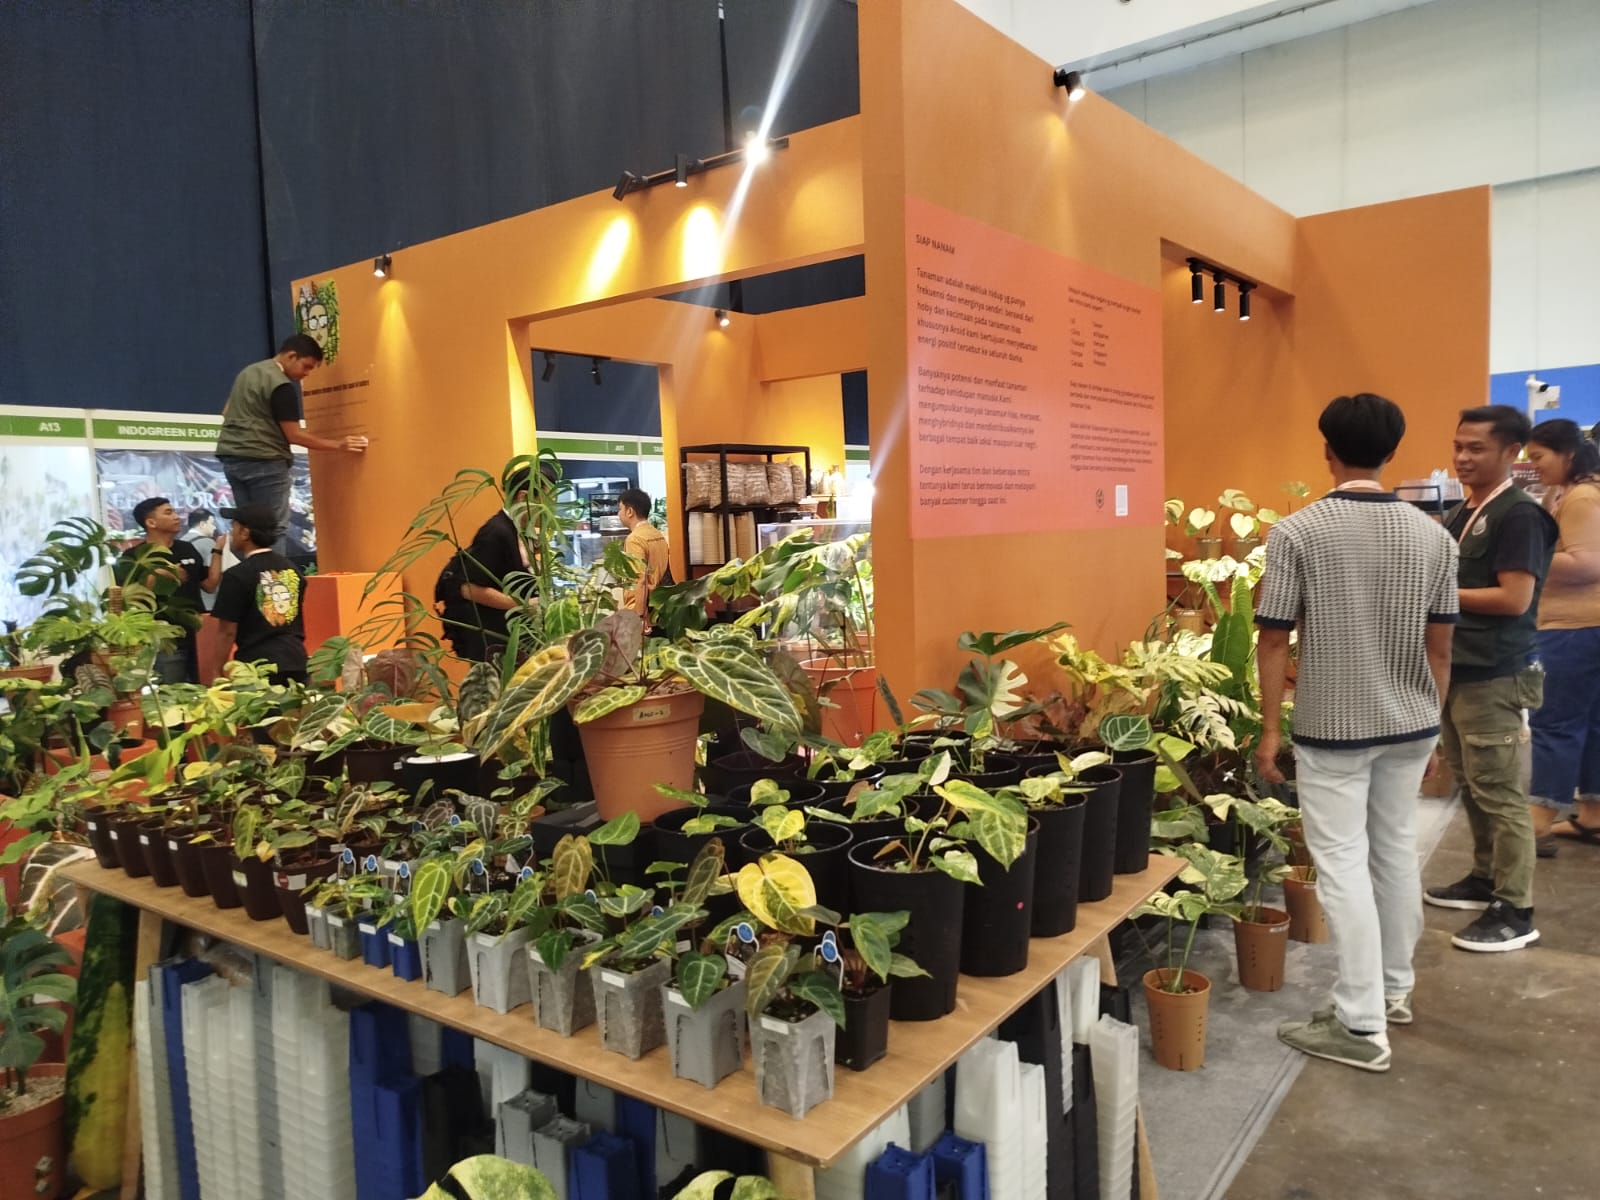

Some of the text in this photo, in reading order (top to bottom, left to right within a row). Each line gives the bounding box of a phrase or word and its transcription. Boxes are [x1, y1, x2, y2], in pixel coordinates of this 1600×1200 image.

[916, 234, 955, 255] SIAP NANAM
[917, 268, 944, 283] Tanaman
[934, 305, 945, 316] dan
[118, 425, 187, 437] INDOGREEN
